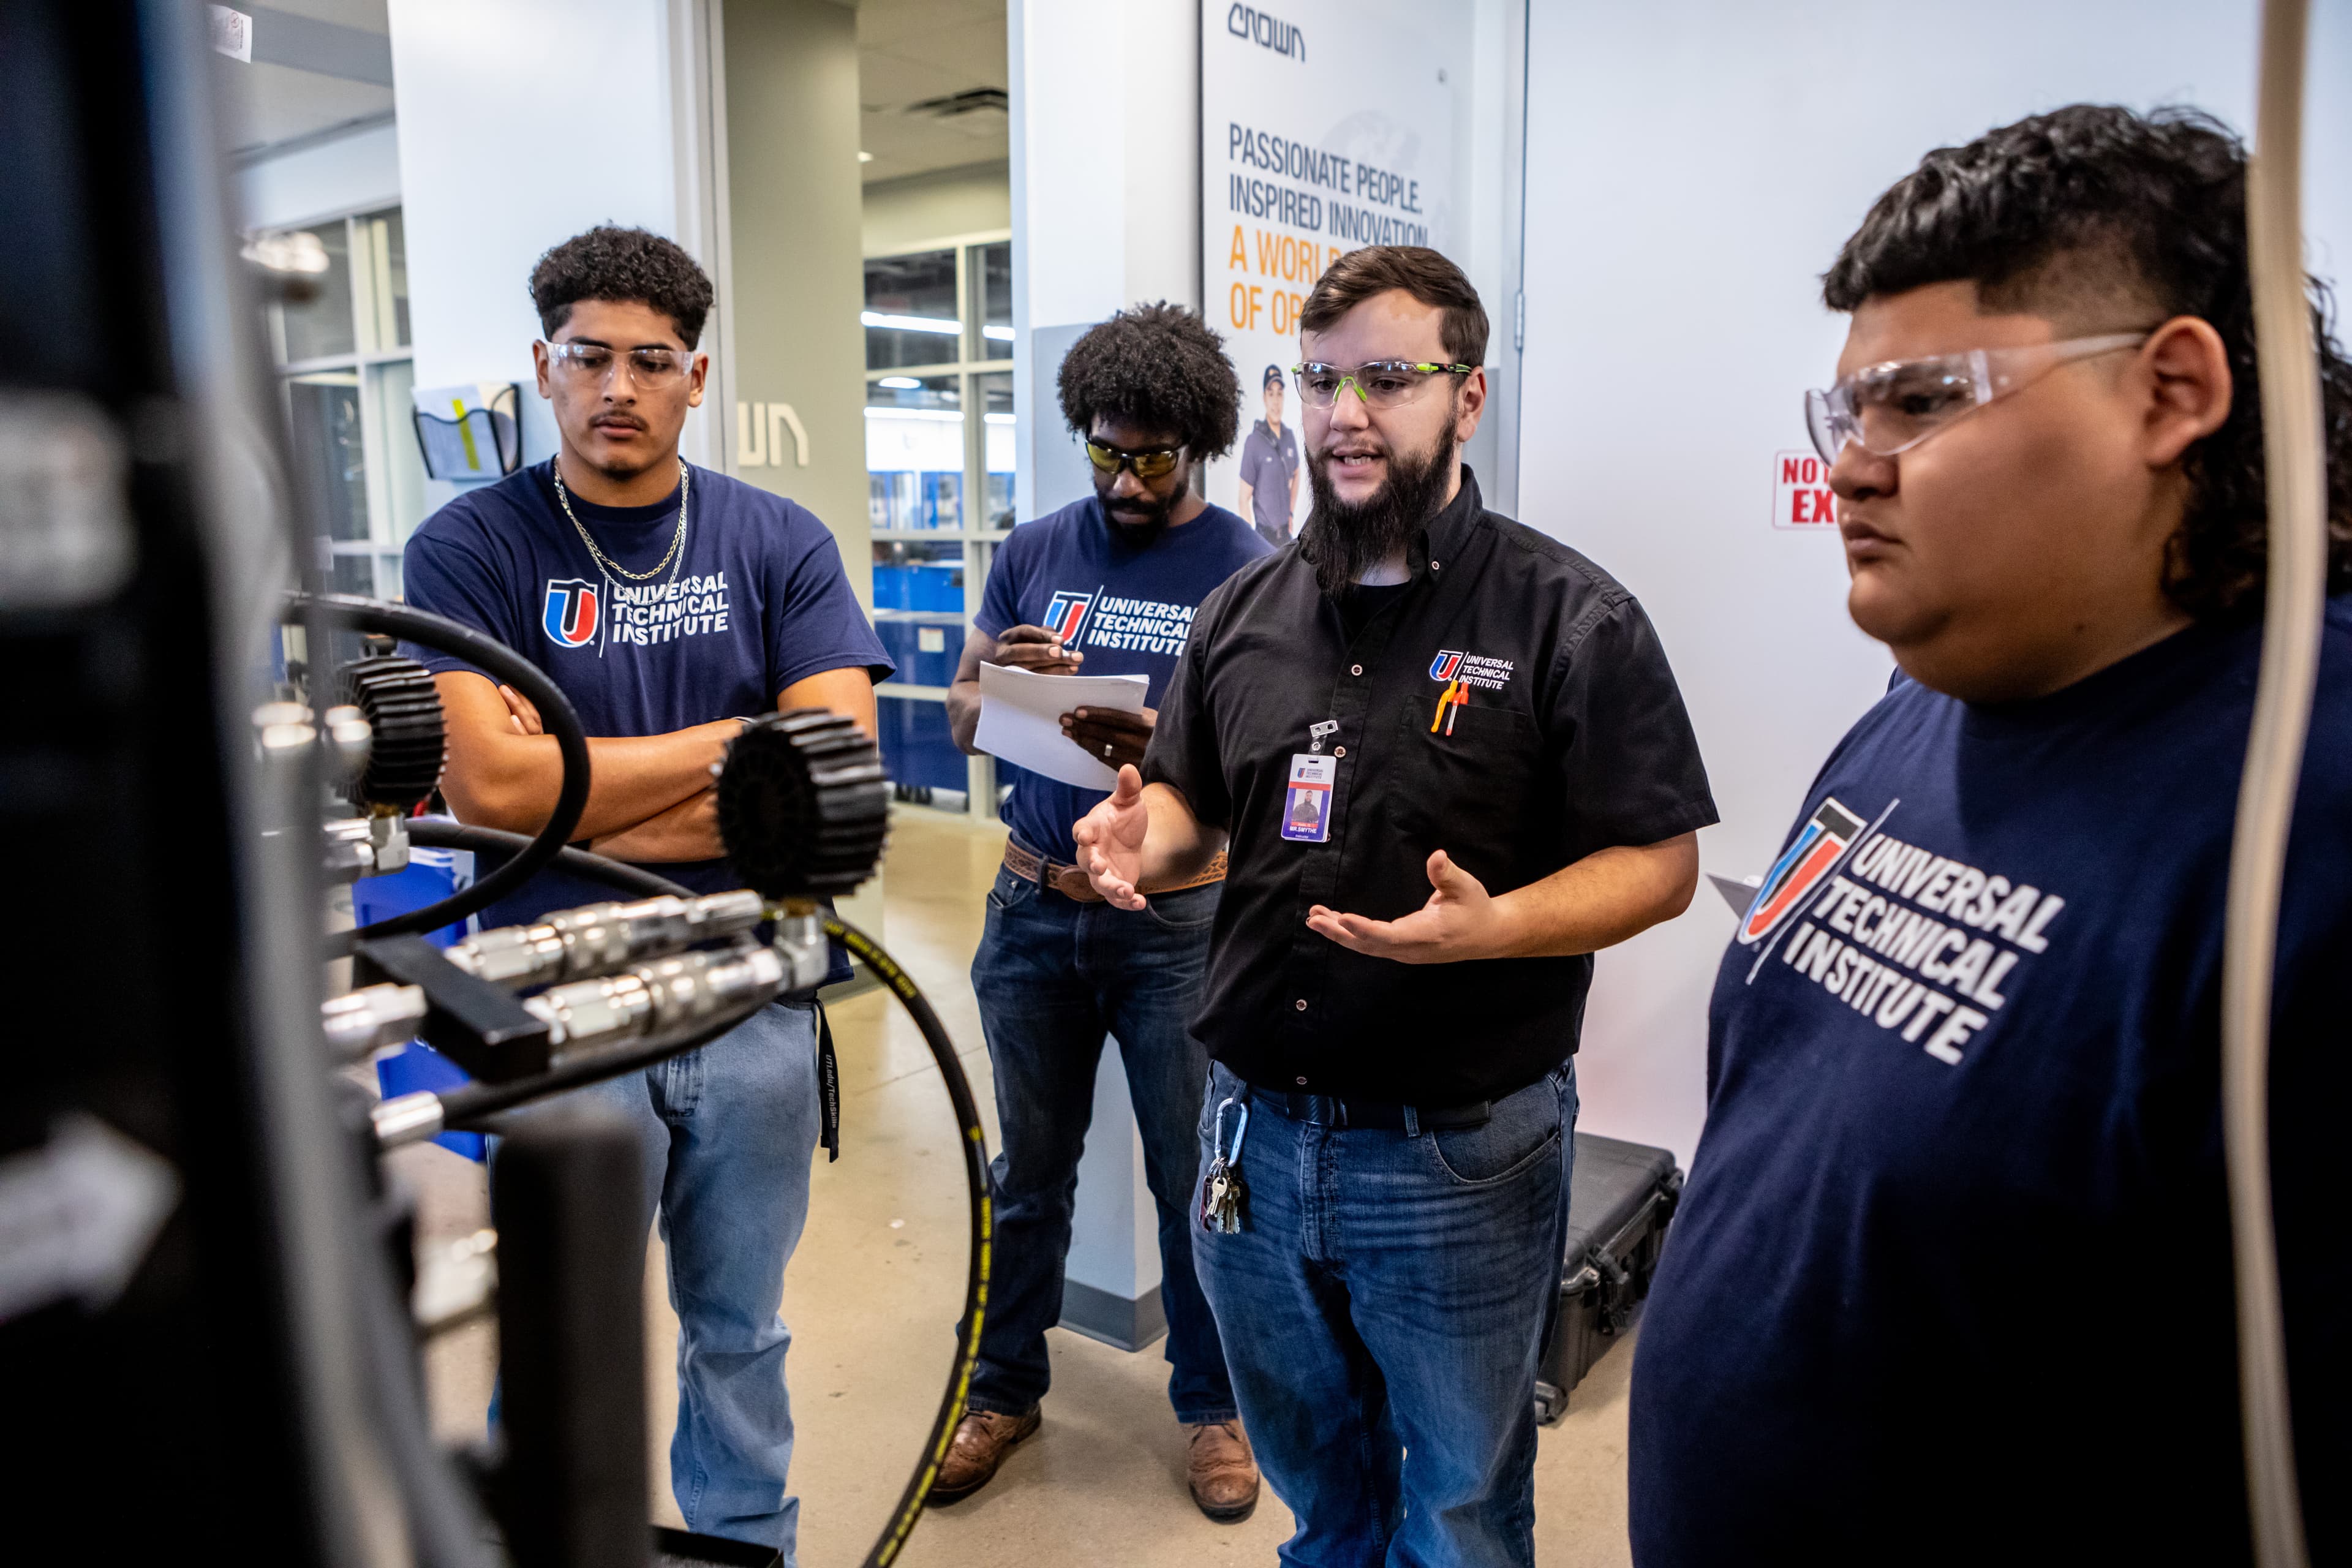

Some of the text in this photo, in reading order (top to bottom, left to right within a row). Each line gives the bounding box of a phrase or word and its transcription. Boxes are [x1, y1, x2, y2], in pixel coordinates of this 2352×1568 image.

[1228, 2, 1306, 62] CROWN
[1229, 122, 1422, 214] PASSIONATE PEOPLE.
[1229, 173, 1322, 231] INSPIRED
[1229, 225, 1248, 272] A
[1230, 282, 1262, 330] OF
[612, 592, 729, 626] TECHNICAL
[614, 571, 728, 605] UNIVERSAL
[612, 611, 728, 646] INSTITUTE
[1459, 675, 1504, 690] INSTITUTE
[1463, 665, 1510, 680] TECHNICAL
[1466, 655, 1513, 669] UNIVERSAL
[1850, 833, 2066, 954] UNIVERSAL
[1812, 875, 2019, 1011] TECHNICAL
[1782, 921, 1989, 1066] INSTITUTE
